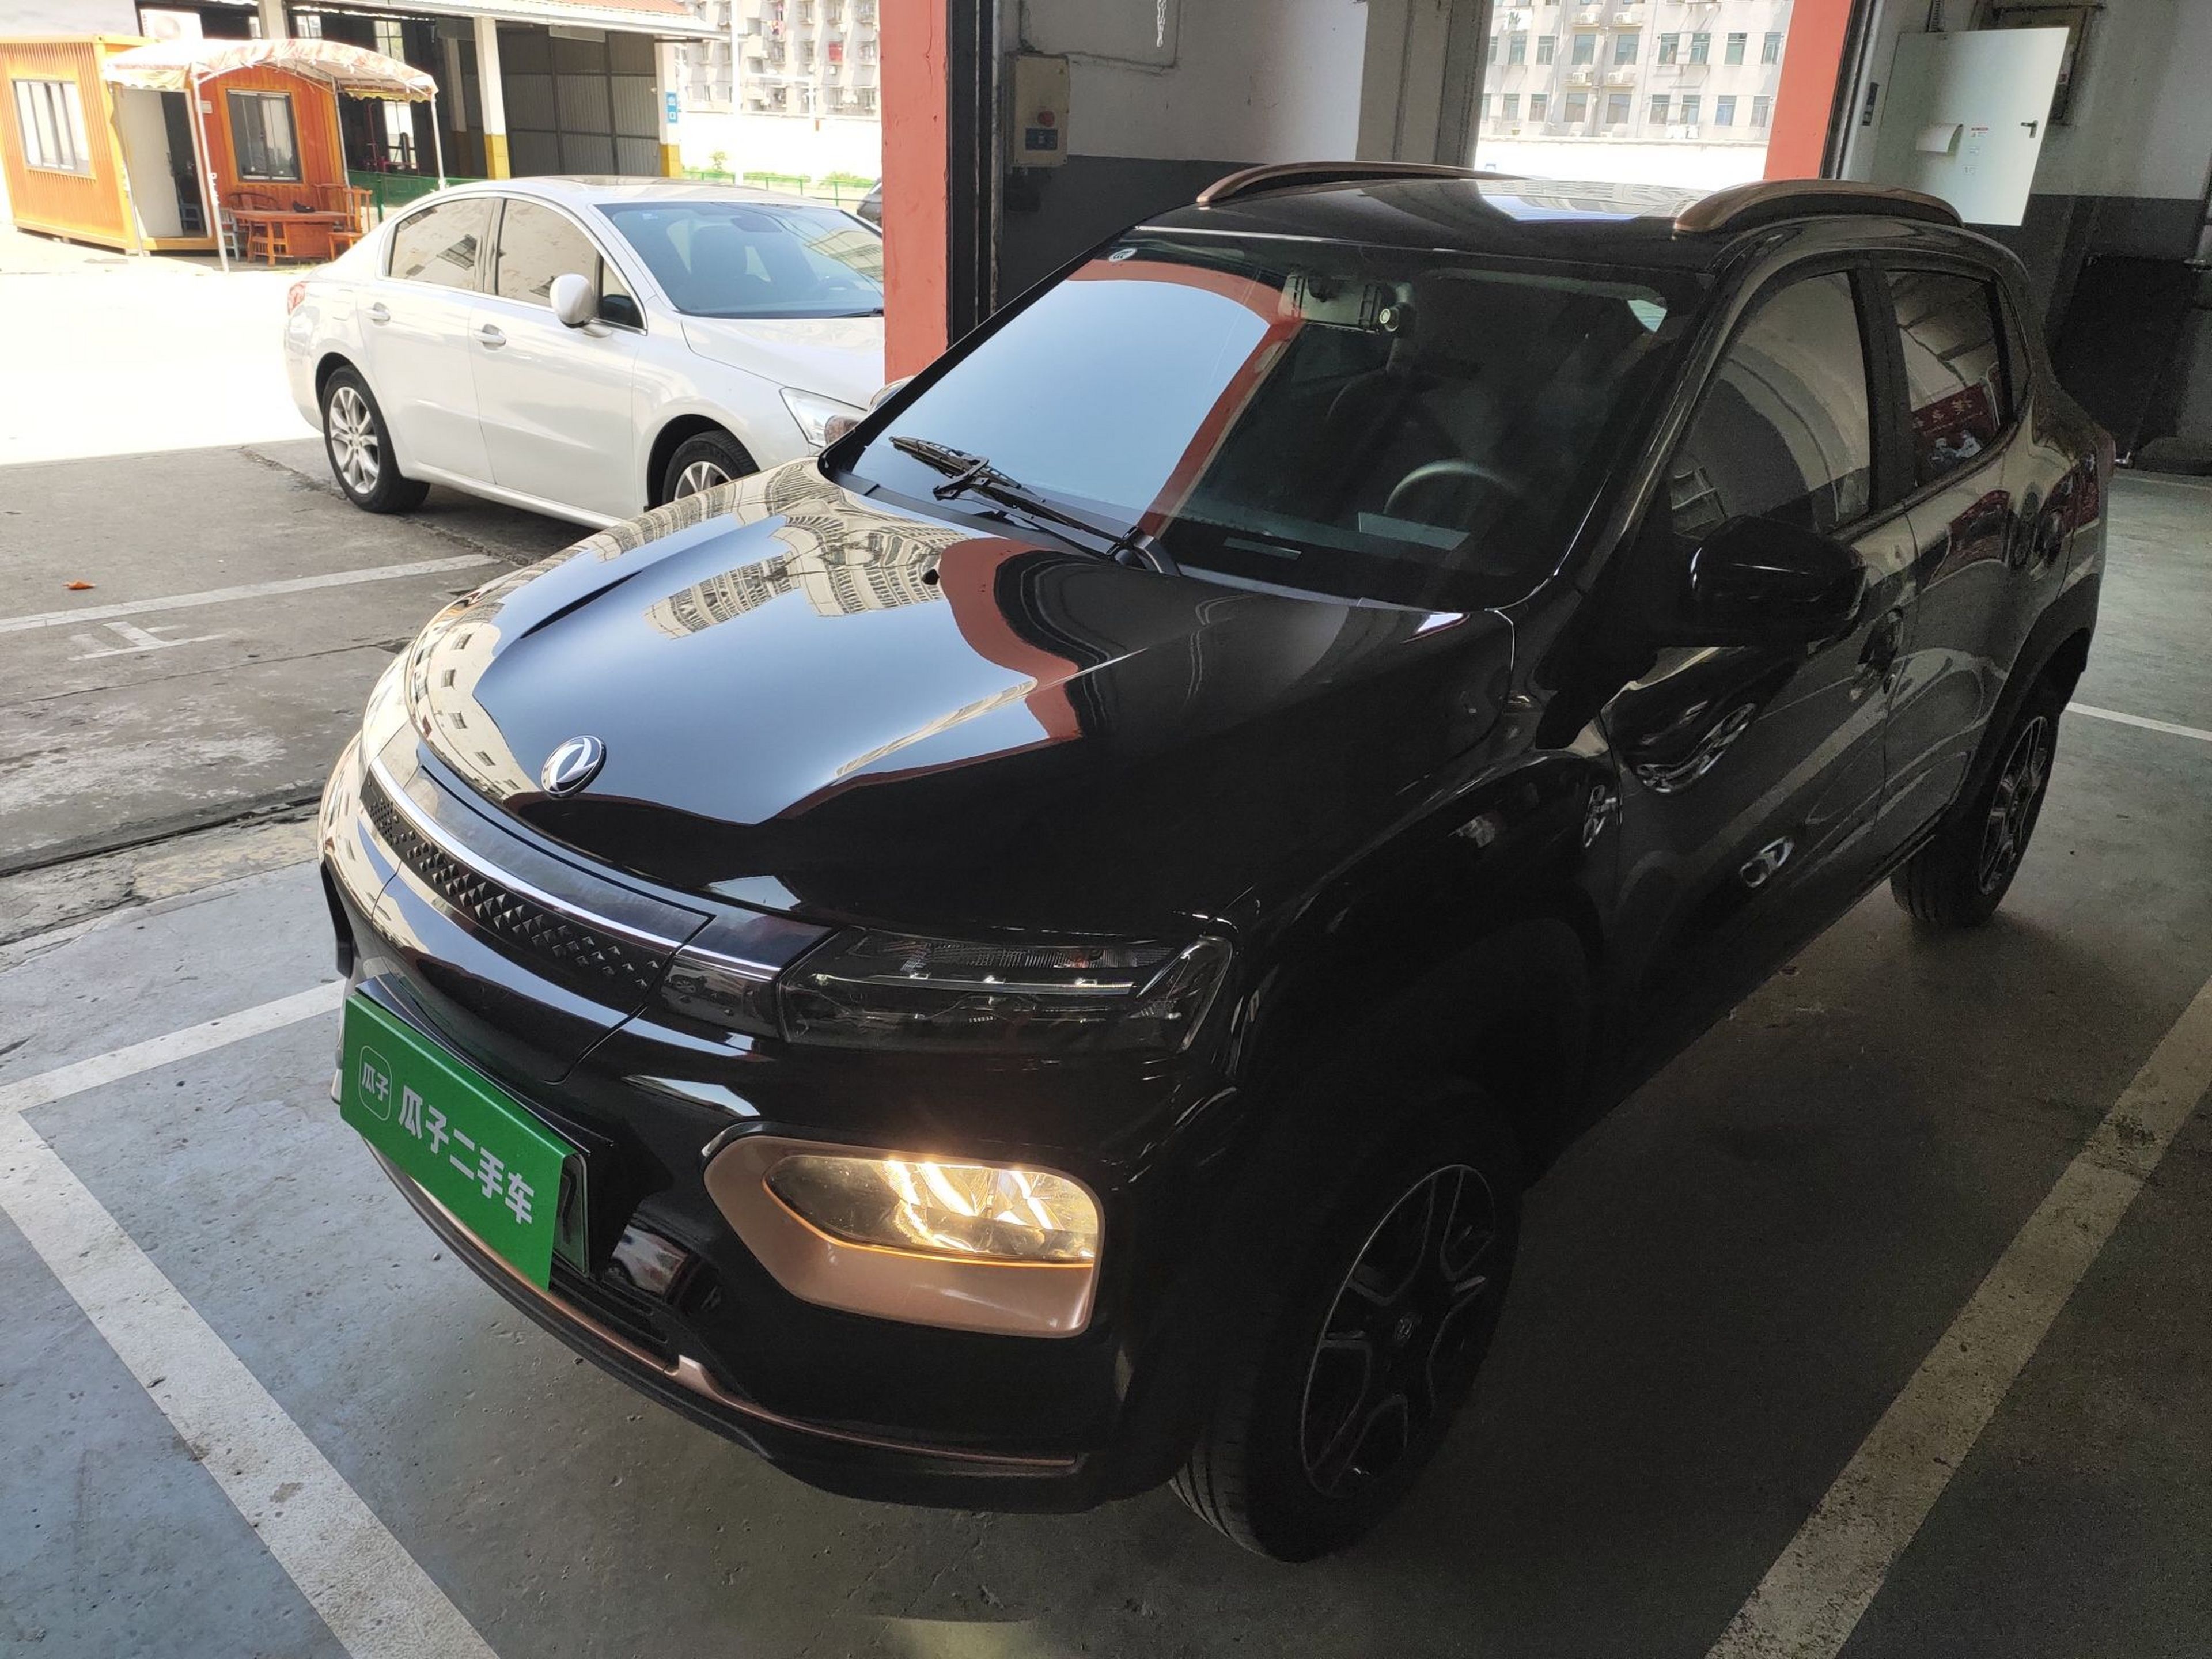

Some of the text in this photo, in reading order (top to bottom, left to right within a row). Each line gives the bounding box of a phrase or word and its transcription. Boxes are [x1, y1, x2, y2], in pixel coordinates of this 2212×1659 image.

[361, 1062, 389, 1102] 瓜子
[399, 1085, 535, 1224] 瓜子二手车
